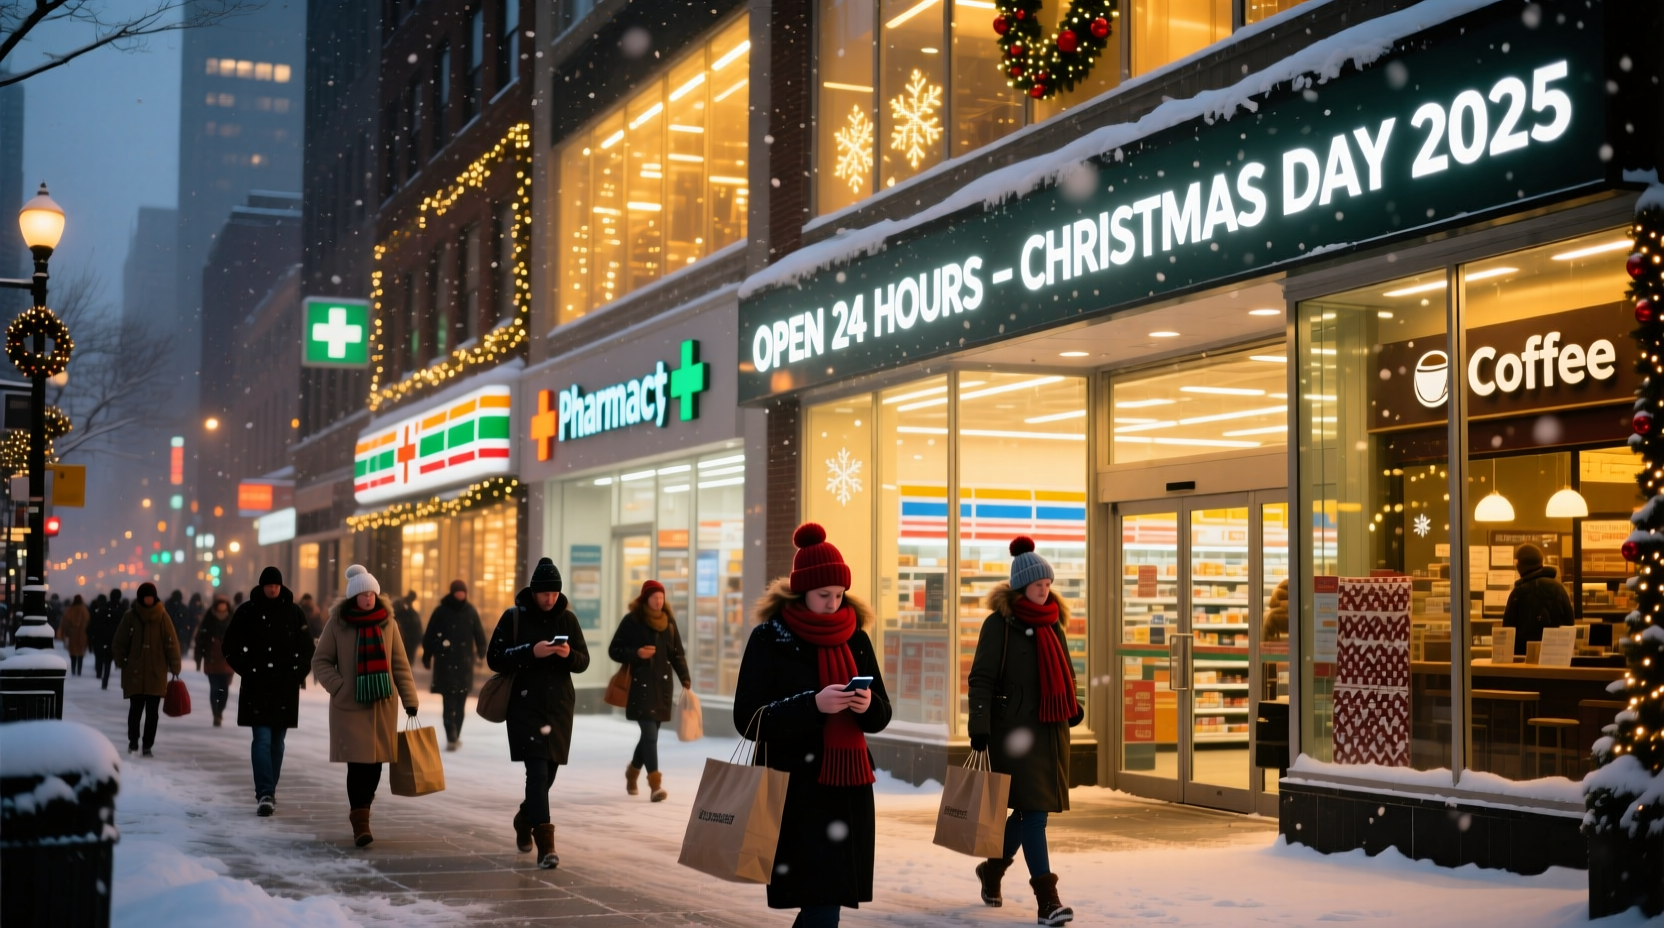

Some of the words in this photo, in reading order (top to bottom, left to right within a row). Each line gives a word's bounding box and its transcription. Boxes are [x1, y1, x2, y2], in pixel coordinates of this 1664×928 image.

[752, 307, 825, 373] OPEN
[831, 294, 868, 351] 24
[873, 255, 984, 338] HOURS
[1020, 162, 1267, 291] CHRISTMAS
[1282, 117, 1396, 216] DAY
[1410, 60, 1572, 179] 2025
[1468, 331, 1616, 396] Coffee
